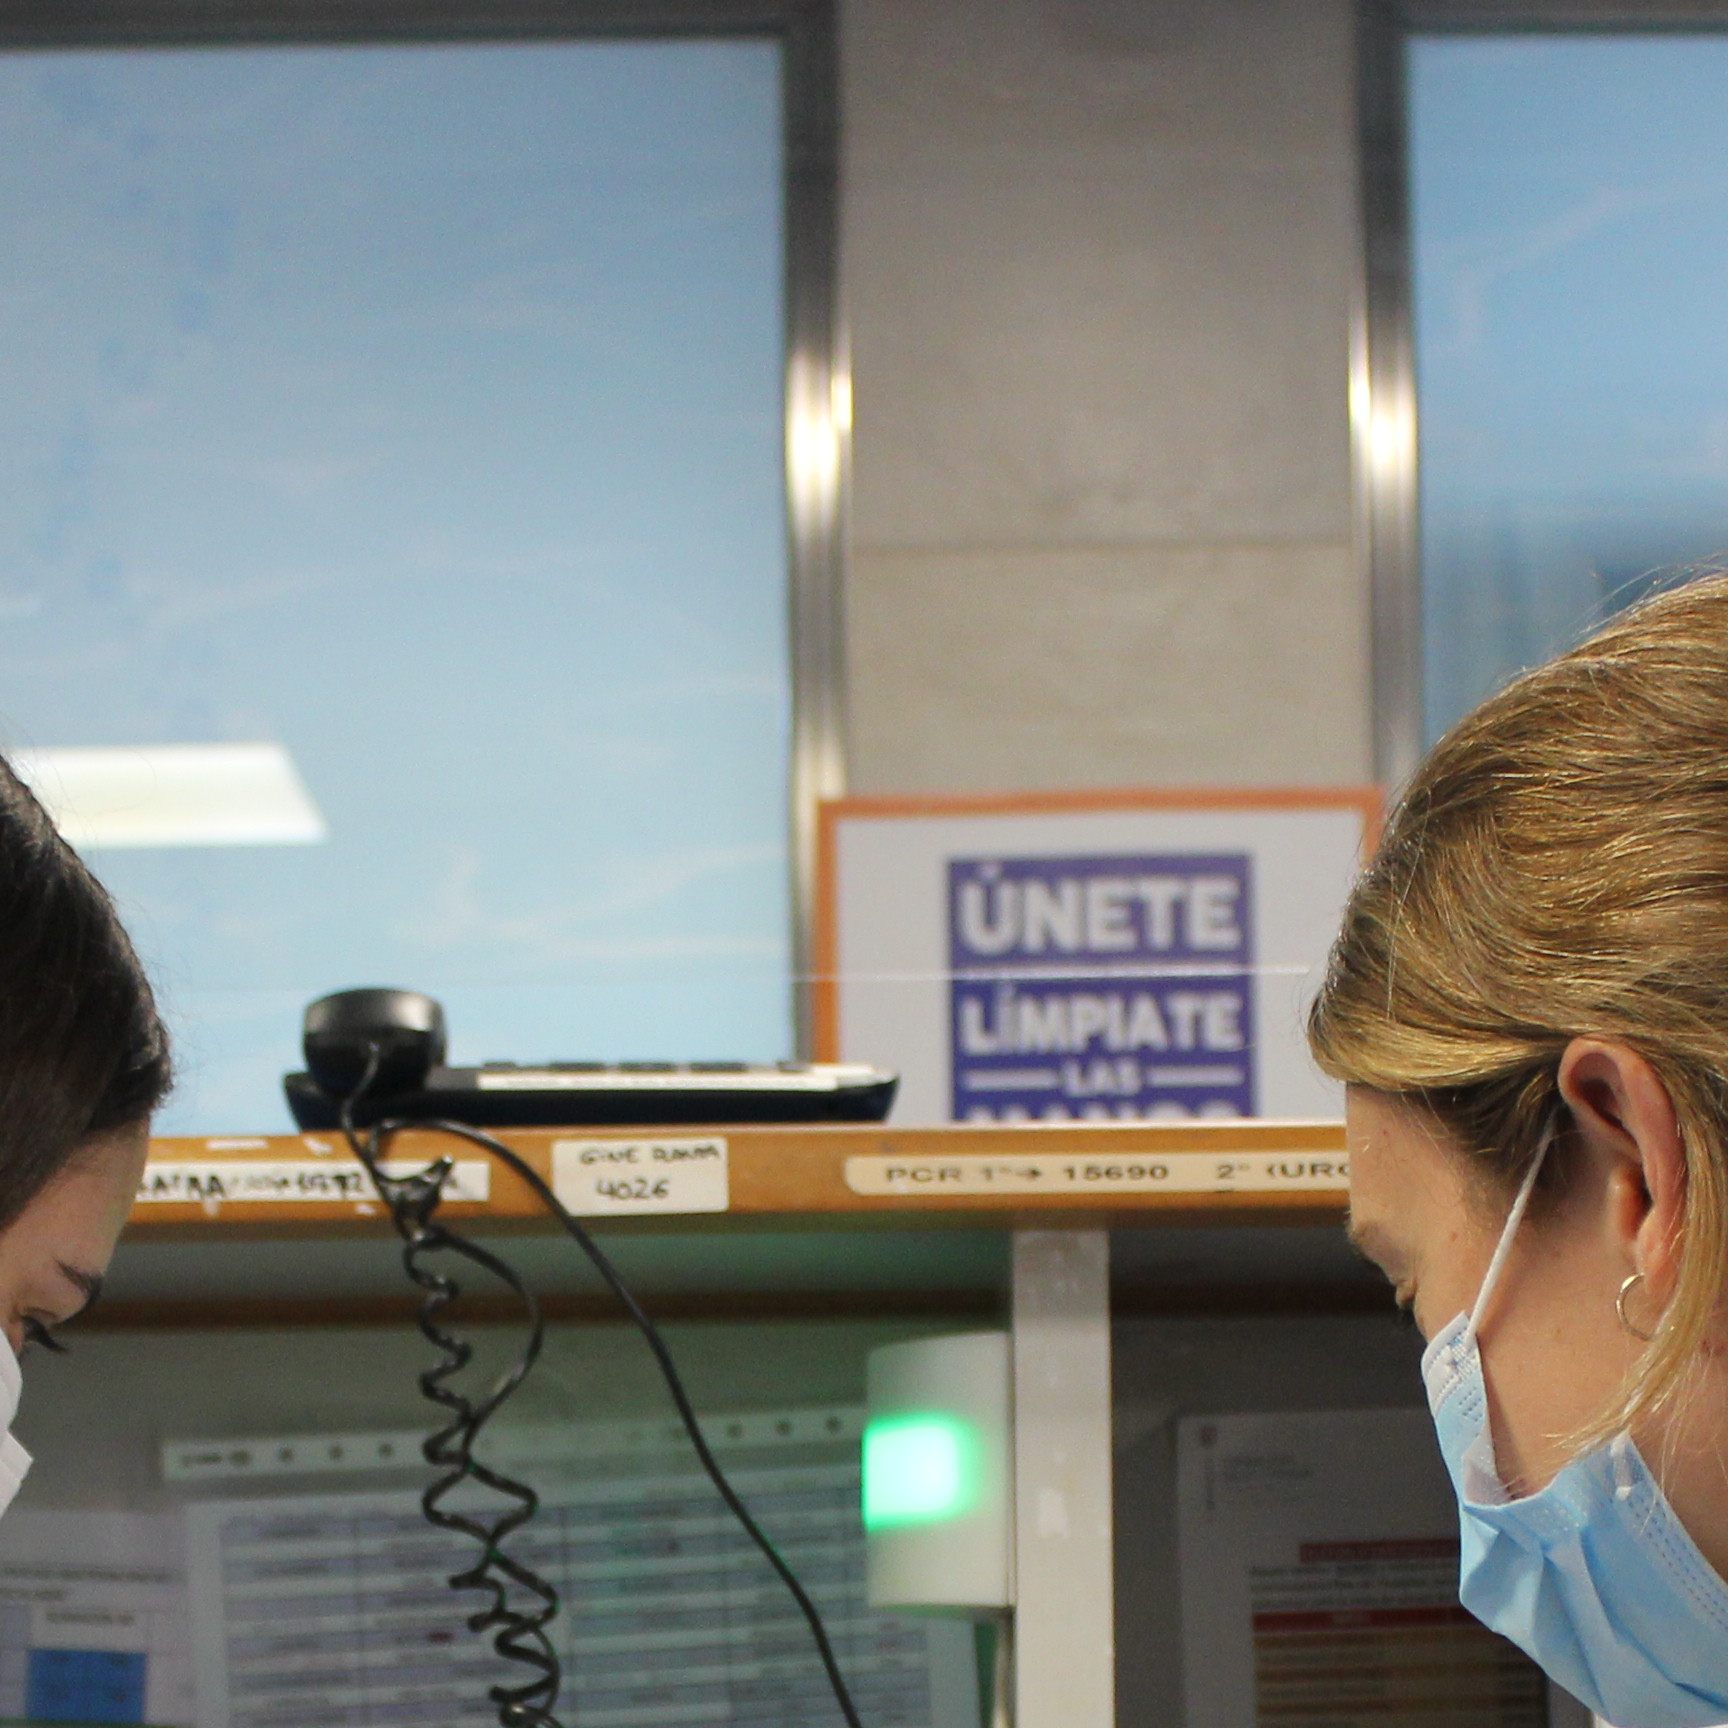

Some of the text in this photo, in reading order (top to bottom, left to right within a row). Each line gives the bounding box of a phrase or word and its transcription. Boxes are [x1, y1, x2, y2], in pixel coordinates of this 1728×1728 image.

[959, 862, 1241, 953] ÚNETE
[961, 984, 1243, 1055] LÍMPIATE
[1060, 1060, 1141, 1097] LAS
[595, 1177, 670, 1200] 4026
[885, 1162, 962, 1184] PCR
[1062, 1163, 1169, 1183] 15690
